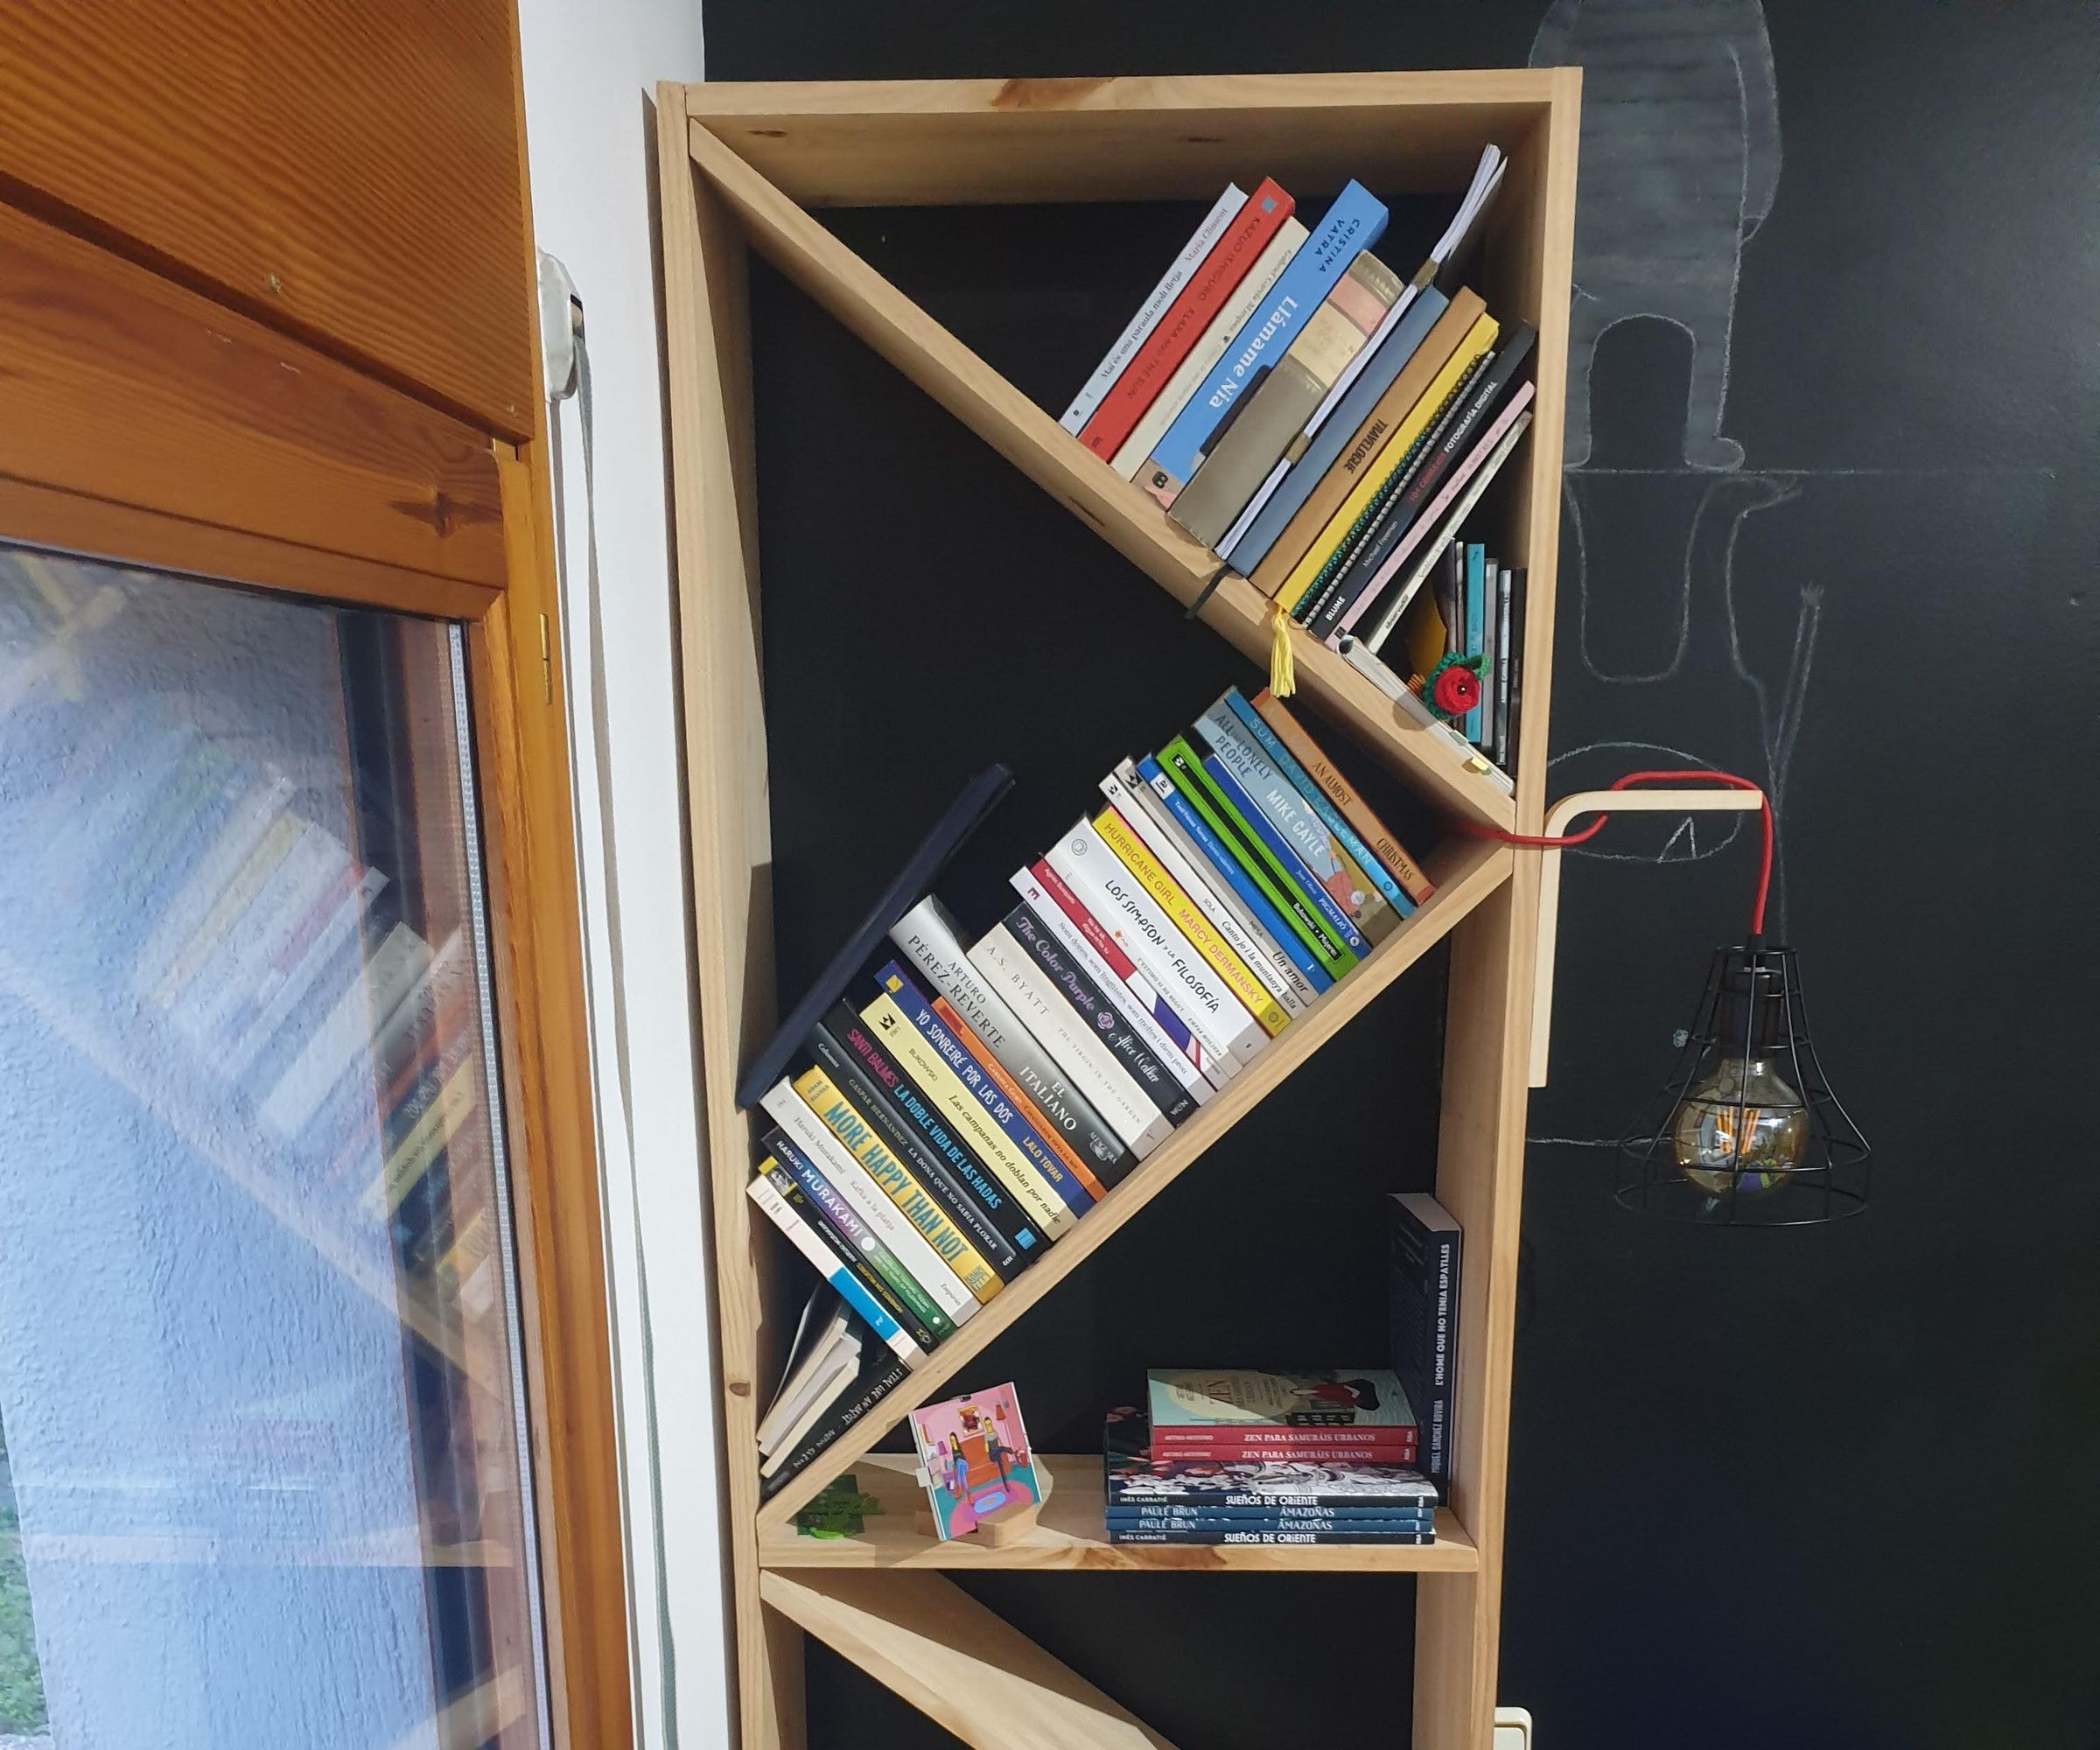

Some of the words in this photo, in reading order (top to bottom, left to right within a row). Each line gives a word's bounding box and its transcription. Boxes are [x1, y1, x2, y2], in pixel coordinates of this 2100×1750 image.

[1231, 215, 1261, 253] KAZUO
[1312, 216, 1346, 258] VATRA
[1317, 216, 1362, 275] CRISTINA
[1128, 307, 1156, 340] paraula
[1230, 292, 1299, 382] Llámame
[1207, 376, 1239, 412] Nia
[1441, 405, 1479, 454] FOTOGRAFÍA
[1473, 378, 1498, 410] DIGITAL
[1341, 417, 1389, 475] TRAVELOGUE
[1324, 595, 1346, 621] BLUME
[1214, 712, 1237, 737] ALL
[1235, 738, 1274, 782] LONELY
[1248, 716, 1278, 749] SUM
[1214, 734, 1253, 779] PEOPLE
[1311, 760, 1330, 779] AN
[1323, 774, 1354, 808] ALMOST
[1264, 788, 1297, 823] MIKE
[1290, 818, 1326, 858] GAYLE
[1375, 836, 1416, 883] CHRISTMAS
[1103, 822, 1157, 883] HURRICANE
[1152, 878, 1178, 906] GIRL
[1177, 907, 1212, 946] MARCY
[1208, 942, 1264, 1006] DERMANSKY
[1220, 919, 1242, 942] Canto
[1292, 900, 1317, 930] Bukowski
[1316, 932, 1339, 958] Mujeres
[1102, 878, 1128, 904] LOS
[1120, 898, 1166, 948] SIMPSON
[1169, 956, 1223, 1014] FILOSOFÍA
[1236, 938, 1249, 951] jo
[1243, 946, 1252, 955] i
[1247, 950, 1258, 962] la
[906, 931, 1009, 1050] PÉREZ-REVERTE
[947, 959, 988, 1005] ARTURO
[985, 943, 1012, 971] A.S.
[1010, 972, 1051, 1018] BYATT
[1251, 957, 1284, 994] muntanya
[1270, 949, 1290, 969] Un
[1283, 964, 1310, 996] amor
[1013, 914, 1040, 943] The
[1032, 935, 1068, 975] Color
[1057, 967, 1100, 1013] Purple
[1106, 1024, 1140, 1060] Alice
[1132, 1049, 1165, 1084] Walker
[1057, 920, 1074, 939] Som
[1087, 957, 1103, 975] som
[1125, 1003, 1141, 1019] som
[1137, 1016, 1159, 1040] moltes
[1158, 1040, 1175, 1060] diem
[1170, 1057, 1187, 1075] prou
[1279, 990, 1298, 1010] balla
[913, 1008, 932, 1026] YO
[925, 1022, 969, 1069] SONREIRÉ
[960, 1064, 983, 1088] POR
[976, 1083, 998, 1106] LAS
[991, 1101, 1015, 1125] DOS
[1057, 1026, 1071, 1042] THE
[1071, 1043, 1095, 1069] VIRGIN
[1093, 1068, 1102, 1079] IN
[1102, 1080, 1116, 1096] THE
[1115, 1094, 1142, 1124] GARDEN
[1017, 1063, 1080, 1134] ITALIANO
[1049, 1080, 1068, 1099] EL
[792, 1115, 817, 1142] Haruki
[844, 1027, 873, 1058] SANTI
[865, 1051, 900, 1088] BALMES
[892, 1082, 912, 1102] LA
[902, 1096, 935, 1130] DOBLE
[927, 1124, 954, 1152] VIDA
[945, 1145, 963, 1164] DE
[956, 1157, 978, 1180] LAS
[970, 1174, 1004, 1210] HADAS
[906, 1046, 940, 1082] BUKOWSKI
[947, 1093, 966, 1112] Las
[958, 1109, 998, 1152] campanas
[993, 1148, 1007, 1162] no
[1003, 1158, 1032, 1189] doblan
[1025, 1186, 1043, 1205] por
[1038, 1199, 1063, 1226] nadie
[813, 1138, 847, 1175] Murakami
[847, 1077, 873, 1106] GASPAR
[906, 1146, 919, 1158] LA
[915, 1156, 936, 1179] DONA
[931, 1175, 948, 1194] QUE
[945, 1191, 959, 1205] NO
[955, 1202, 976, 1224] SABIA
[971, 1222, 998, 1250] PLORAR
[1021, 1135, 1043, 1158] LALO
[1038, 1155, 1063, 1183] TOVAR
[774, 1139, 805, 1172] HARUKI
[797, 1167, 865, 1238] MURAKAMI
[821, 1098, 873, 1152] MORE
[858, 1142, 914, 1199] HAPPY
[899, 1187, 945, 1236] THAN
[929, 1225, 970, 1265] NOT
[848, 1178, 869, 1200] Kafka
[869, 1201, 880, 1213] la
[874, 1208, 897, 1233] platja
[1438, 1243, 1449, 1289] ESPATLLES
[1438, 1291, 1447, 1316] TENIA
[1436, 1333, 1446, 1352] QUE
[1437, 1319, 1446, 1332] NO
[881, 1366, 905, 1389] STEAL
[1435, 1353, 1445, 1385] L'HOME
[839, 1401, 864, 1425] ARTIST
[859, 1395, 874, 1410] AN
[792, 1446, 816, 1469] KLEON
[1285, 1450, 1330, 1459] SAMURÁIS
[1225, 1494, 1262, 1505] SUEÑOS
[1264, 1496, 1277, 1505] DE
[1170, 1520, 1196, 1529] BRUN
[1224, 1532, 1260, 1543] SUEÑOS
[1263, 1534, 1275, 1543] DE
